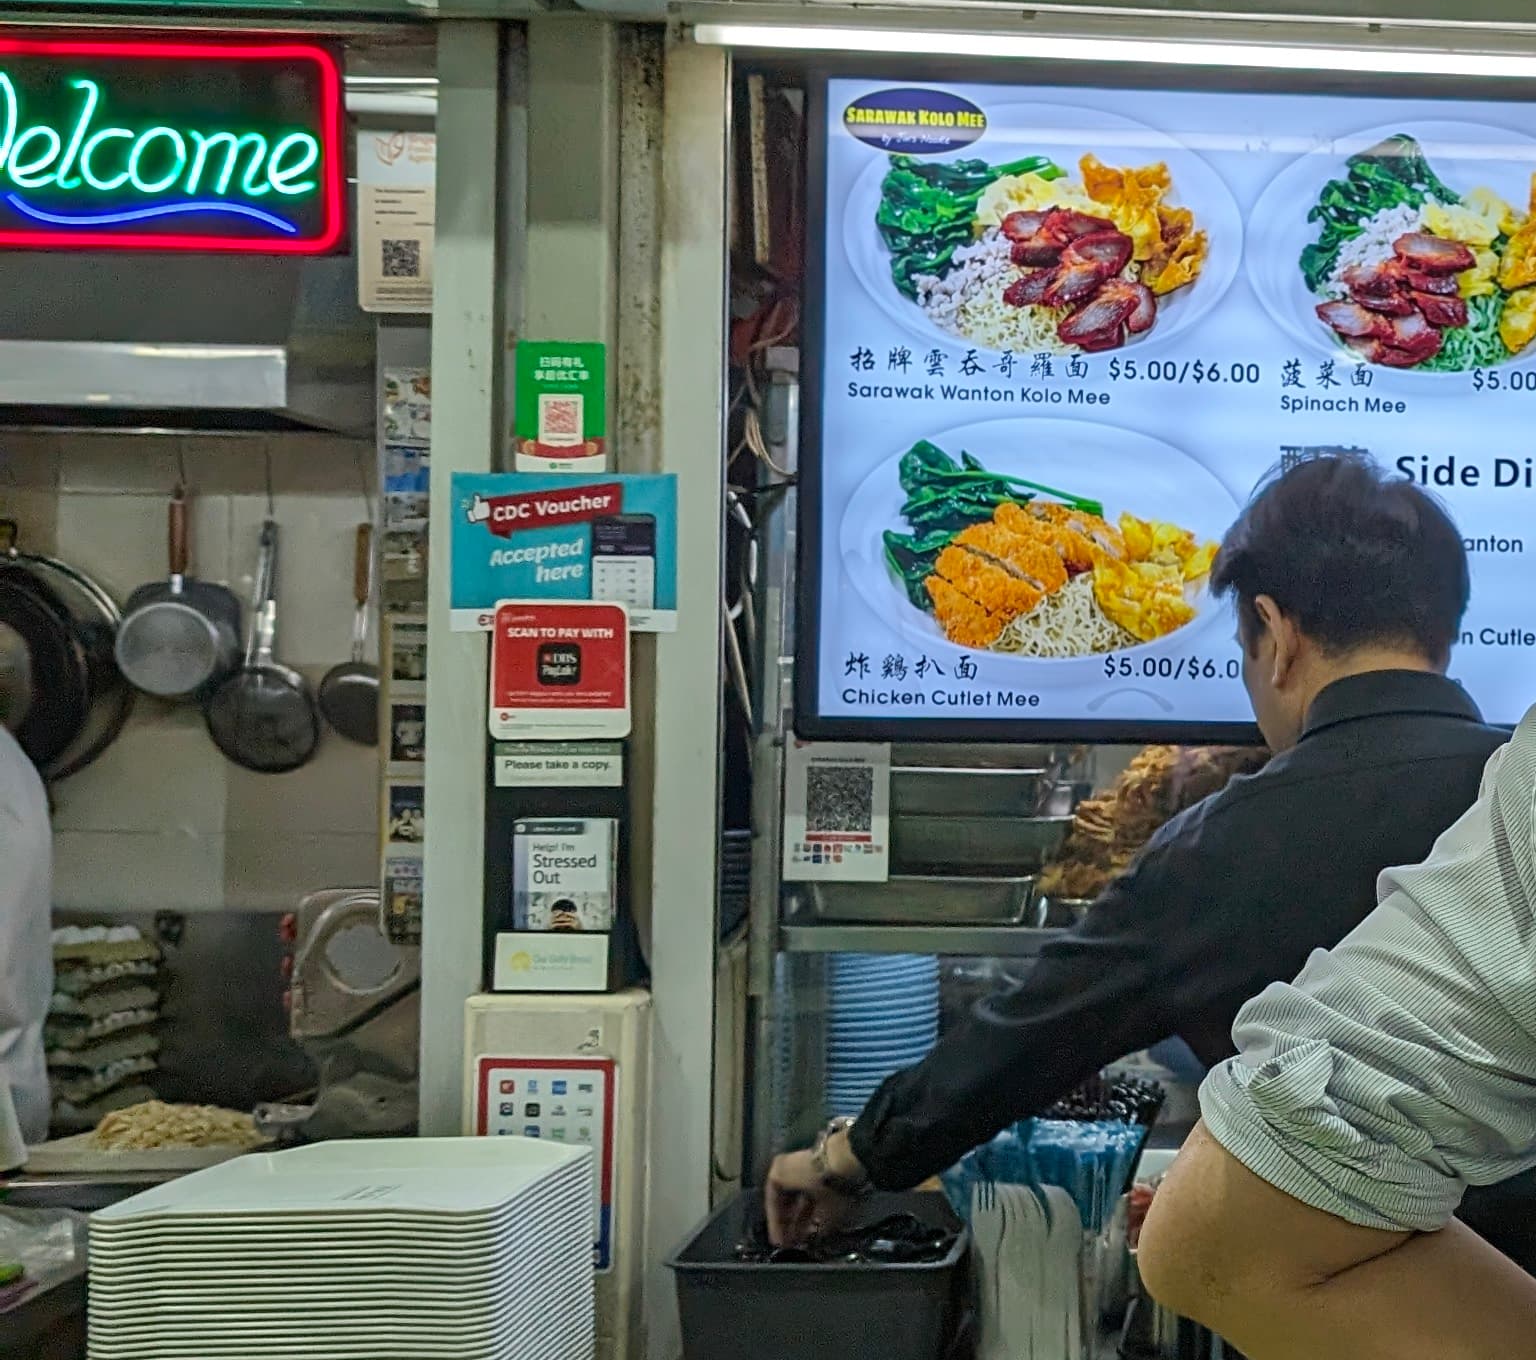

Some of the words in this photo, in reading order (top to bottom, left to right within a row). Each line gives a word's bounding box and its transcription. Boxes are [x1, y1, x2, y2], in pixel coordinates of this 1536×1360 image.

[846, 106, 916, 125] SARAWAK
[918, 109, 955, 127] KOLO
[957, 111, 985, 128] MEE
[1108, 357, 1260, 384] $5.00/$6.00
[1280, 358, 1374, 390] 菠菜面
[848, 382, 934, 401] Sarawak
[940, 385, 1014, 403] Wanton
[1020, 387, 1062, 404] Kolo
[1068, 389, 1111, 406] Mee
[1281, 394, 1359, 414] Spinach
[1364, 397, 1407, 414] Mee
[1396, 455, 1480, 487] Side
[493, 503, 530, 522] CDC
[534, 494, 612, 517] Voucher
[489, 538, 584, 567] Accepted
[1464, 536, 1524, 553] anton
[536, 562, 585, 583] here
[507, 627, 538, 638] SCAN
[541, 627, 556, 639] TO
[558, 628, 579, 639] PAY
[580, 628, 614, 639] WITH
[1103, 657, 1240, 679] $5.00/$6.0
[841, 687, 926, 705] Chicken
[931, 689, 992, 706] Cutlet
[997, 691, 1040, 707] Mee
[505, 759, 542, 769] Please
[546, 760, 569, 770] take
[572, 761, 579, 769] a
[533, 853, 597, 869] Stressed
[533, 870, 561, 885] Out
